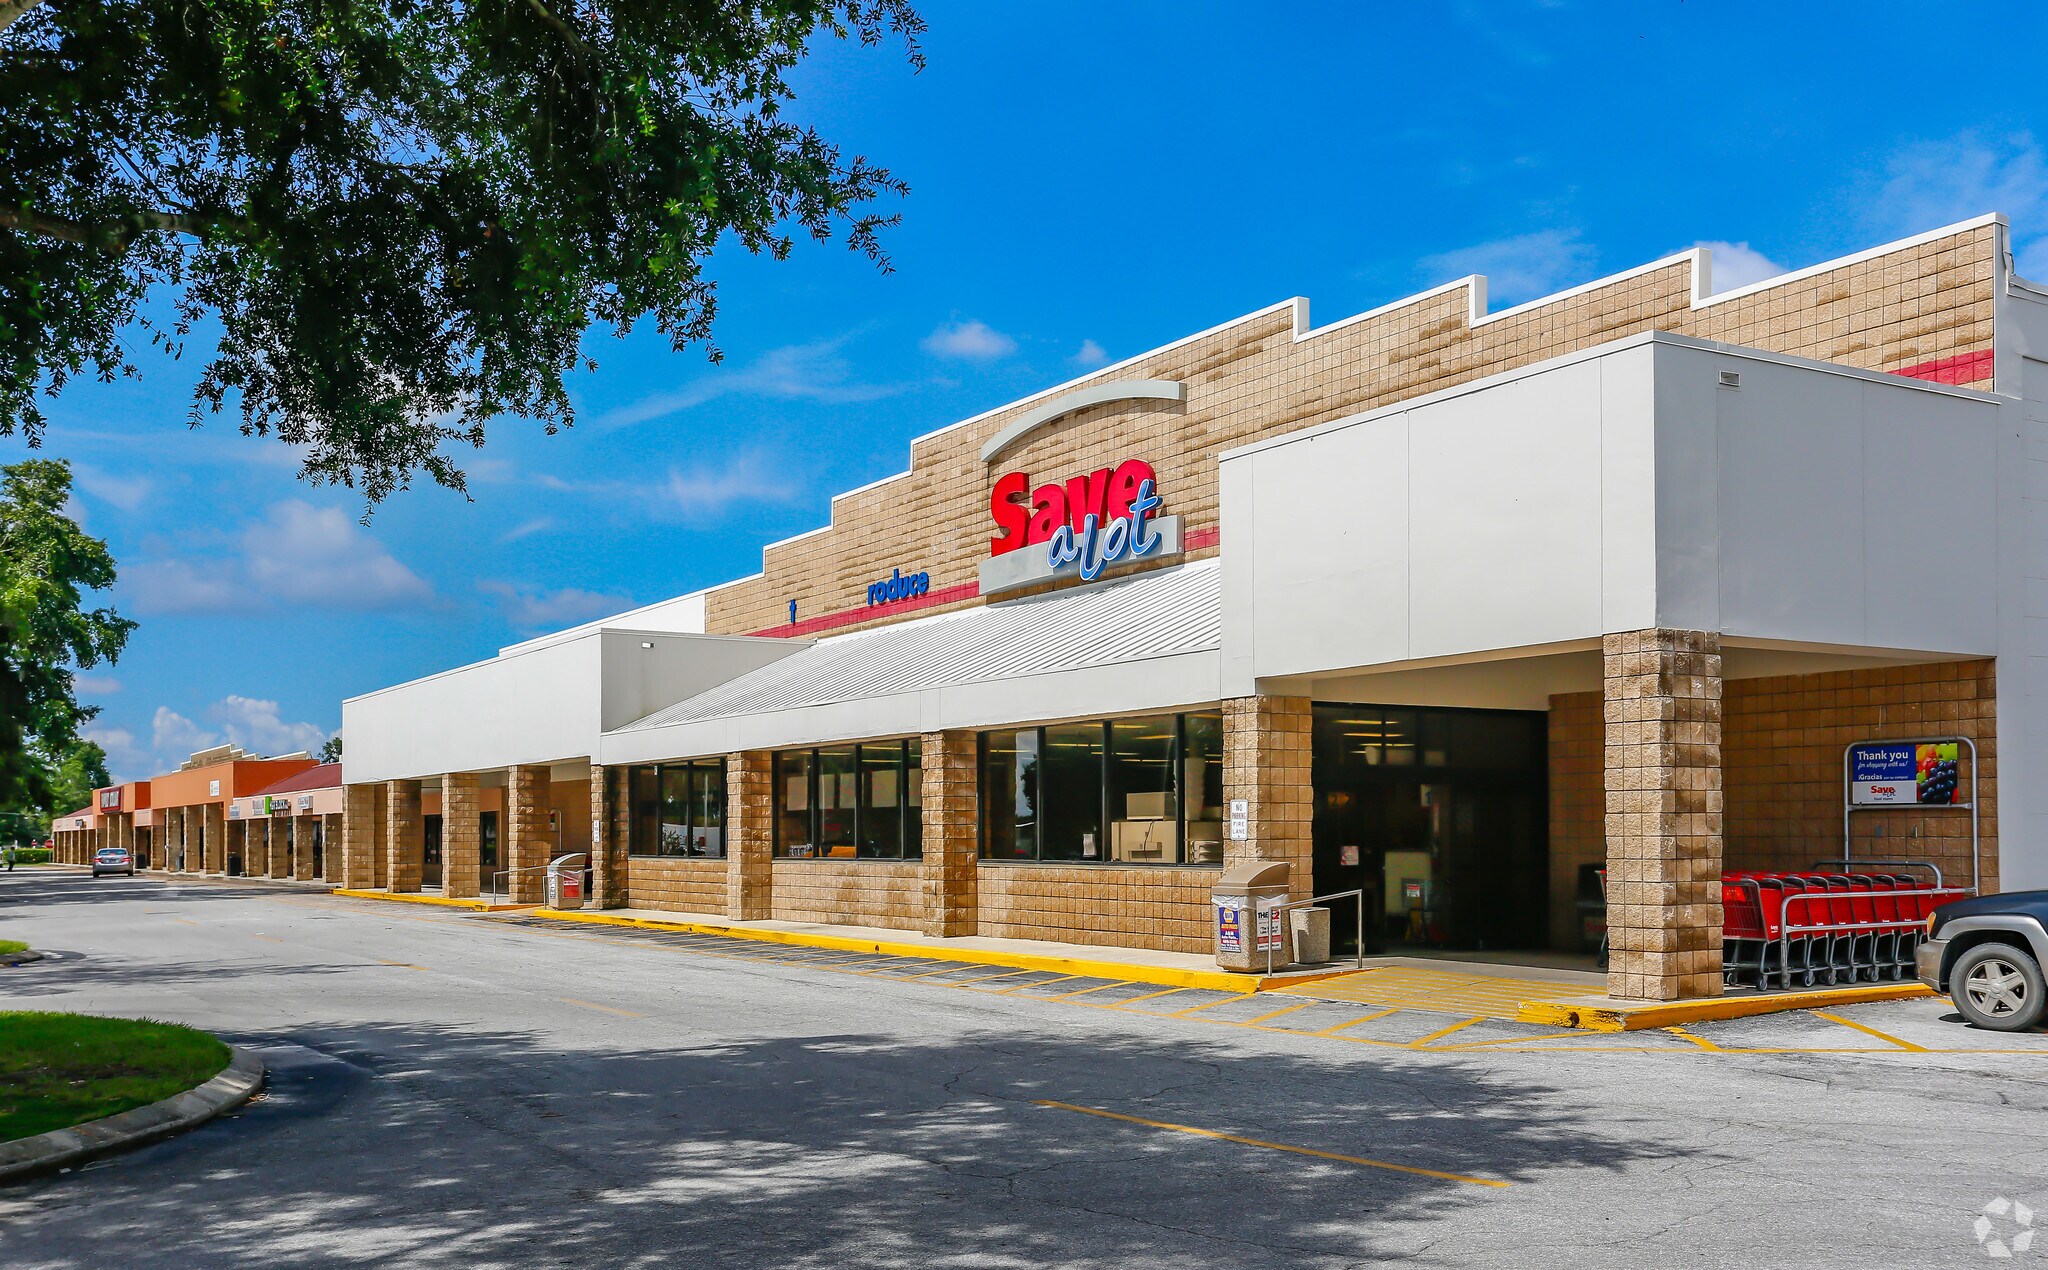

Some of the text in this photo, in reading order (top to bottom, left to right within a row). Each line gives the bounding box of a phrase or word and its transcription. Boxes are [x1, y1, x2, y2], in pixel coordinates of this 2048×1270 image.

[991, 459, 1157, 557] Save
[867, 568, 929, 606] roduce
[1857, 750, 1909, 762] Thank you
[1870, 785, 1896, 794] Save
[1235, 803, 1243, 811] NO
